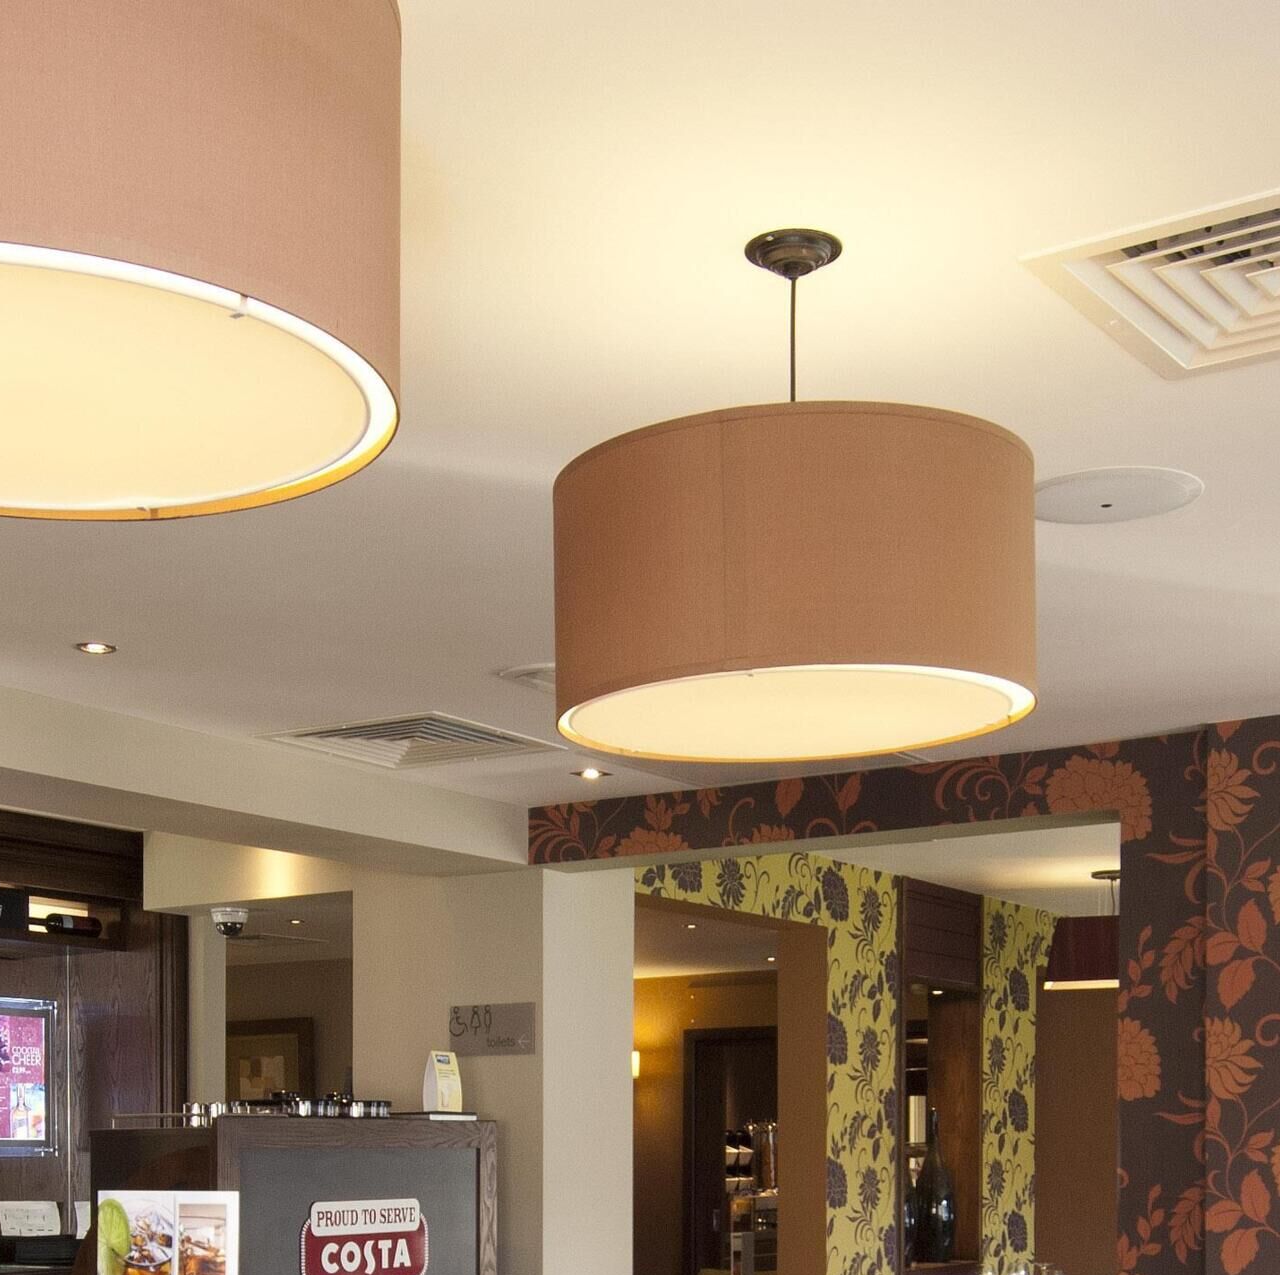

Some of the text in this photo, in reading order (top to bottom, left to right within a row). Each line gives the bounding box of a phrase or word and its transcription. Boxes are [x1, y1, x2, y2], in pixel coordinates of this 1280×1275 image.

[486, 1036, 516, 1048] toilets
[11, 1054, 42, 1066] CHEER
[316, 1206, 416, 1228] PROUD TO SERVE
[321, 1238, 412, 1275] COSTA
